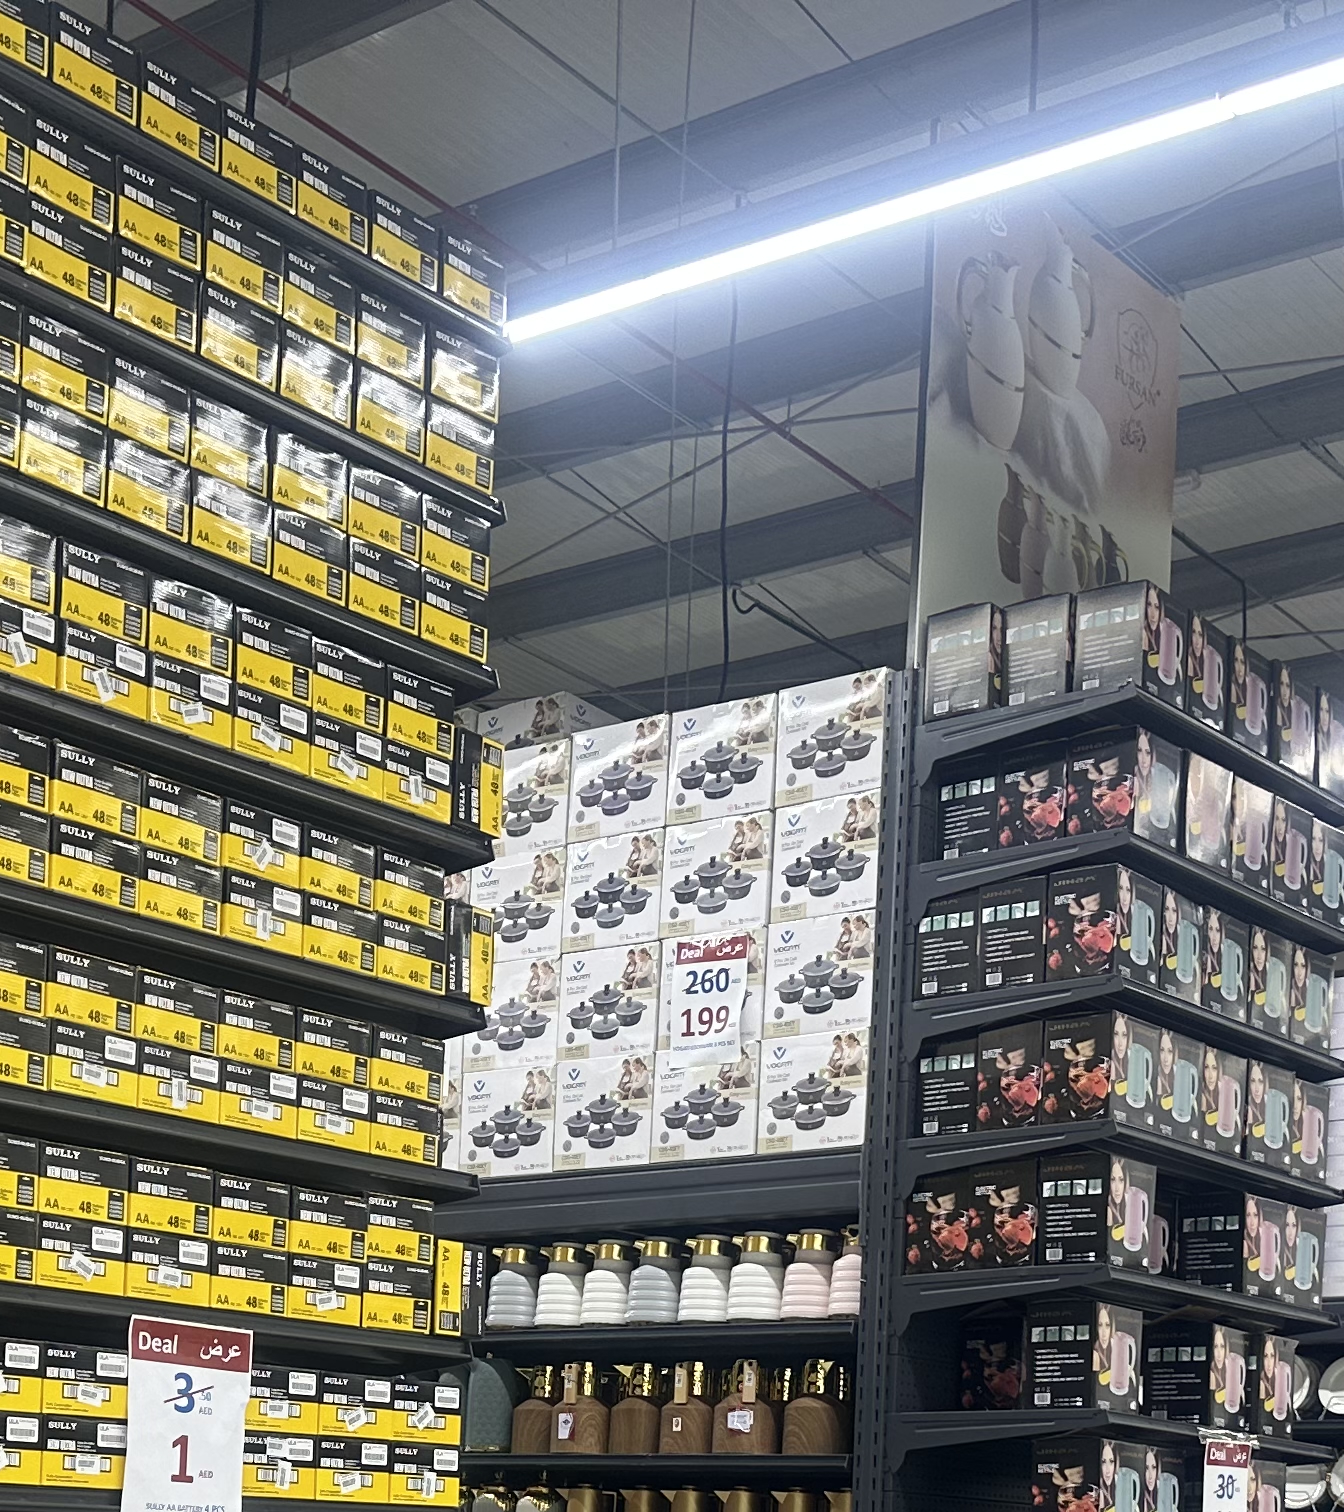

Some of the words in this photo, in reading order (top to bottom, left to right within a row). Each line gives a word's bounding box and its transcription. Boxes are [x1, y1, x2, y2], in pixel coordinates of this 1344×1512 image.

[146, 61, 177, 85] SULLY
[36, 118, 69, 144] SULLY
[146, 116, 159, 132] AA
[175, 131, 188, 147] 48
[123, 164, 155, 187] SULLY
[212, 209, 243, 231] SULLY
[1114, 365, 1155, 407] FURSAN
[60, 749, 96, 767] SULLY
[56, 952, 90, 968] SULLY
[716, 944, 744, 956] عرض
[686, 968, 730, 994] 260
[681, 1006, 729, 1037] 199
[45, 1146, 81, 1160] SULLY
[220, 1178, 251, 1191] SULLY
[138, 1331, 178, 1354] Deal
[200, 1339, 242, 1362] عرض
[174, 1372, 195, 1414] 3
[199, 1407, 213, 1415] AED
[170, 1435, 194, 1483] 1
[199, 1470, 214, 1478] AED
[1209, 1448, 1226, 1461] Deal
[1216, 1474, 1235, 1499] 30
